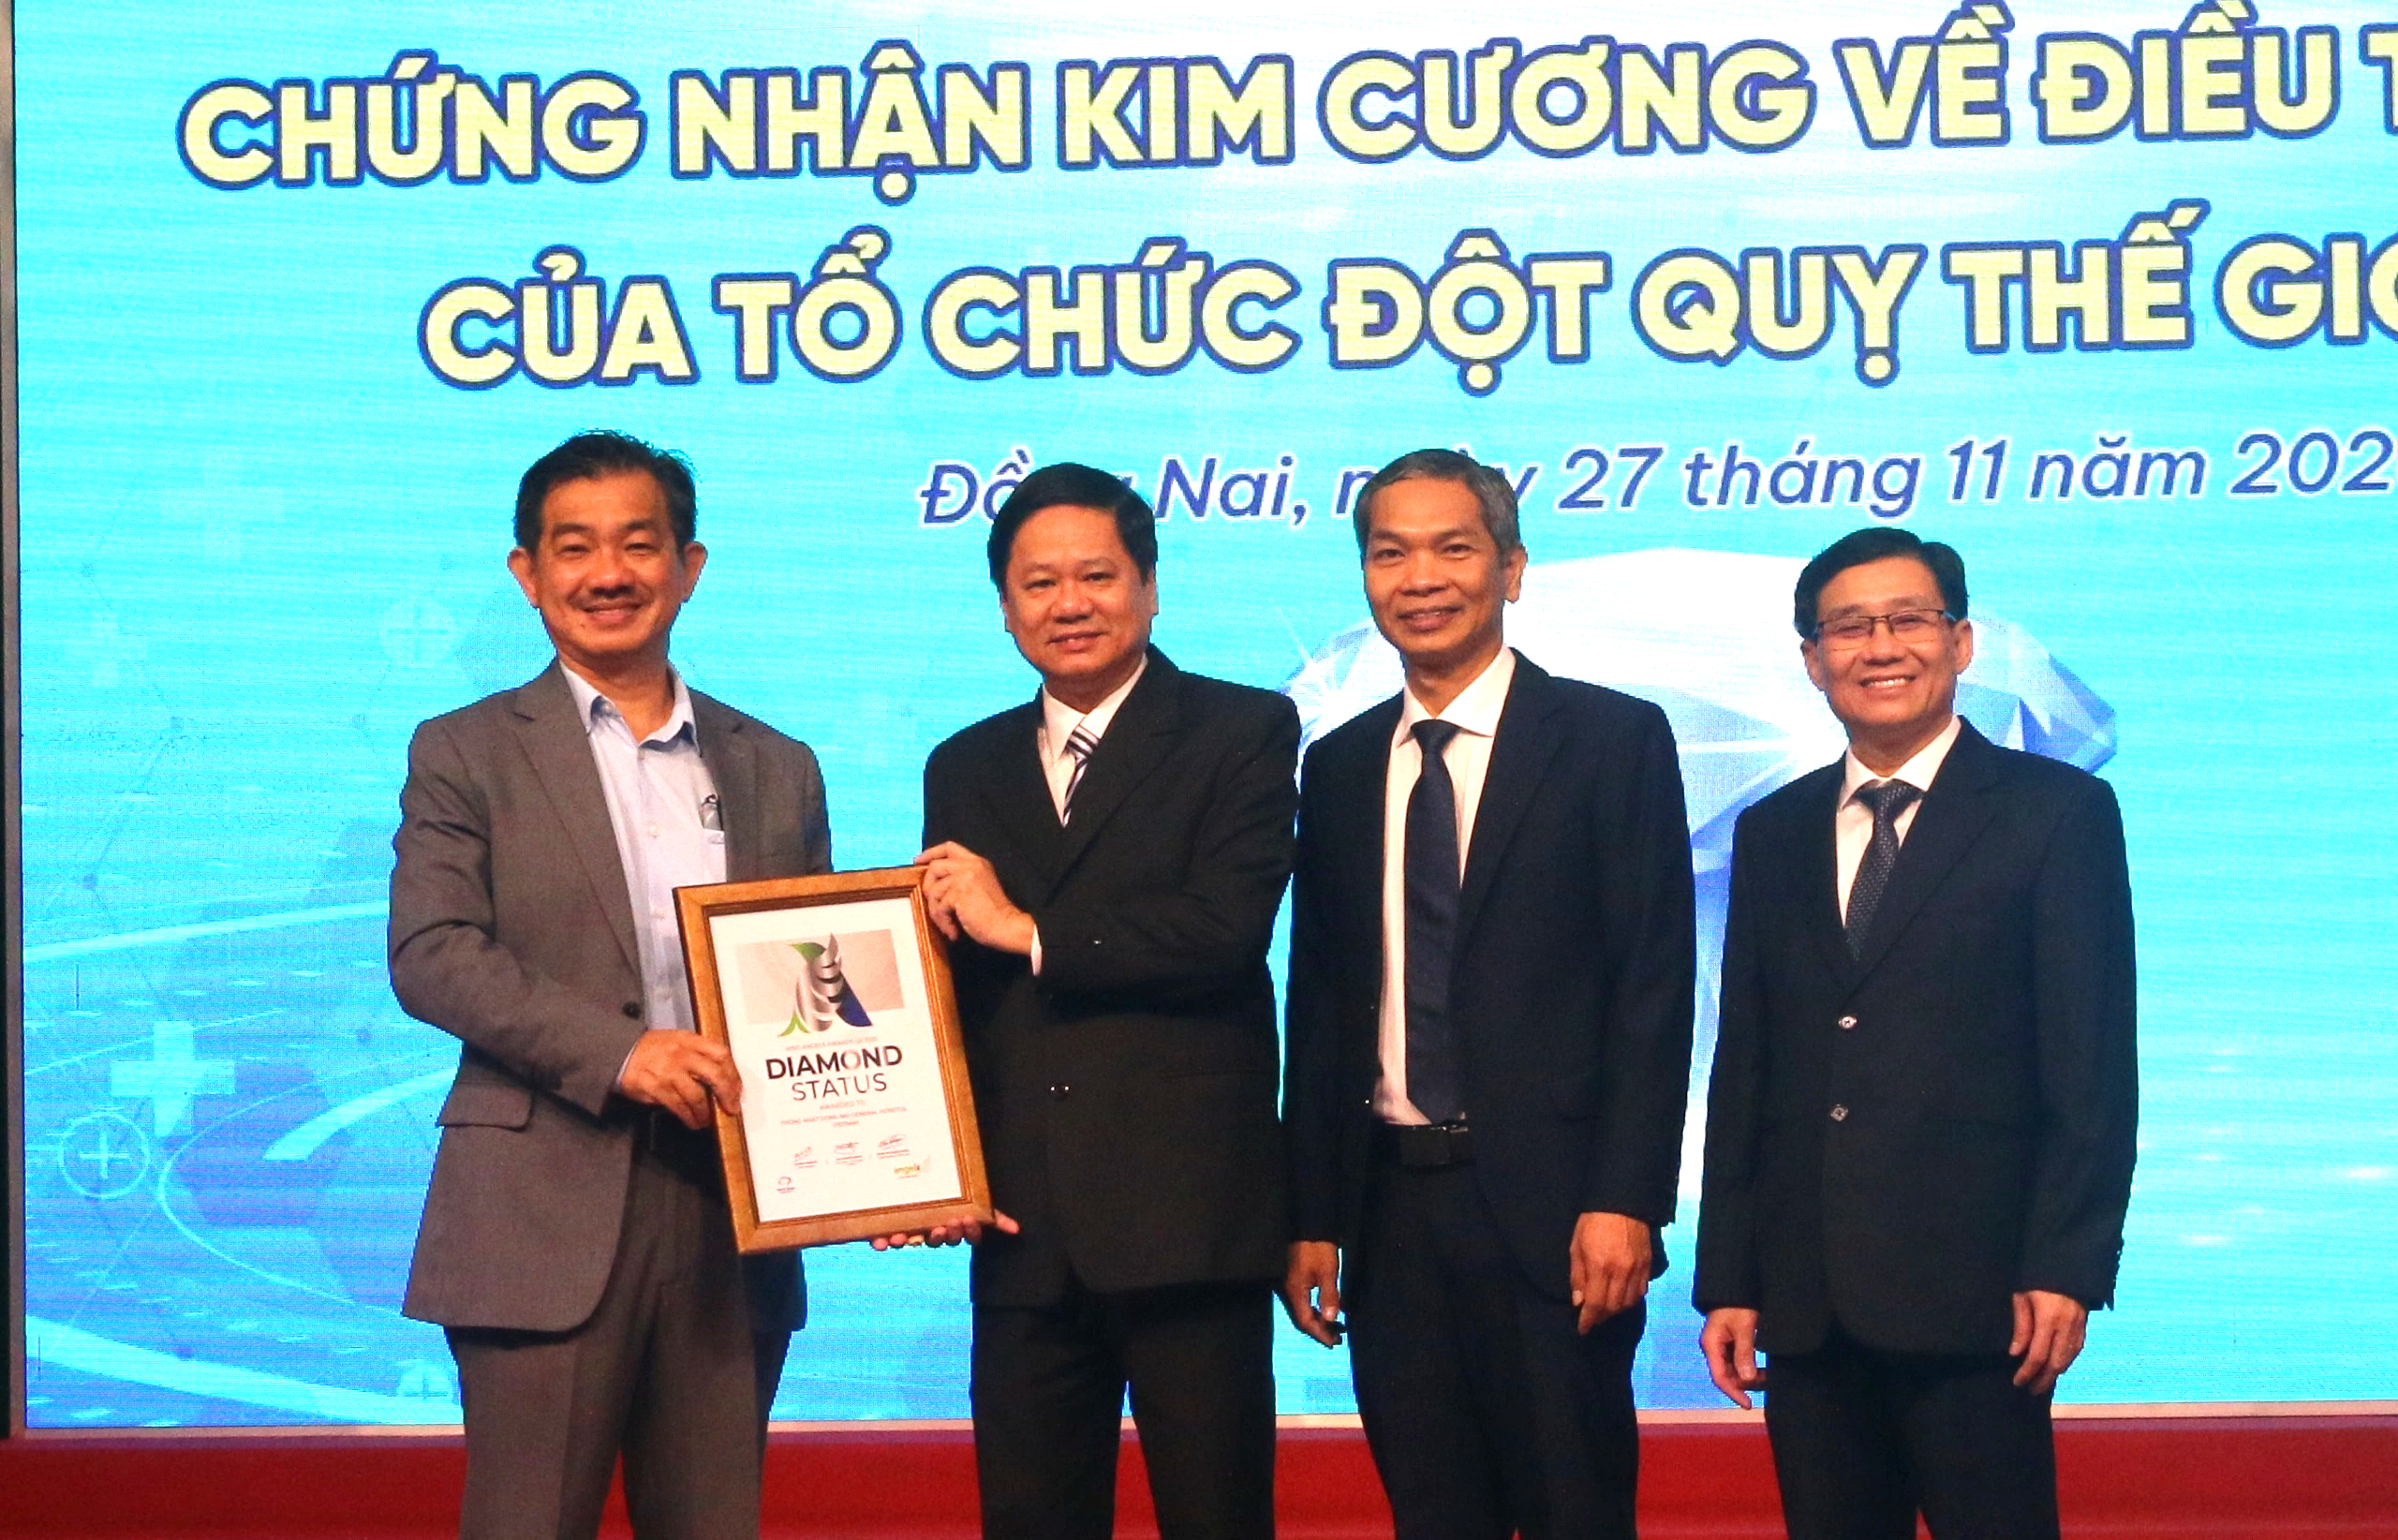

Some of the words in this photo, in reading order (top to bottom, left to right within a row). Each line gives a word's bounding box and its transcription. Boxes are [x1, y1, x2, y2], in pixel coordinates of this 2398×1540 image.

[178, 48, 646, 188] CHỨNG
[672, 40, 1030, 204] NHẬN
[1058, 54, 1295, 172] KIM
[1319, 36, 1816, 164] CƯƠNG
[1835, 0, 2015, 150] VỀ
[2030, 0, 2339, 145] ĐIỀU
[419, 245, 700, 391] CỦA
[712, 225, 902, 384] TỔ
[922, 235, 1301, 382] CHỨC
[1323, 229, 1611, 395] ĐỘT
[1632, 243, 1926, 390] QUỴ
[1943, 198, 2211, 354] THẾ
[1155, 455, 1309, 526] Nai,
[1558, 446, 1664, 511] 27
[1685, 438, 1921, 520] tháng
[1947, 437, 2008, 501] 11
[2029, 435, 2208, 499] năm
[765, 1044, 903, 1079] DIAMOND
[791, 1073, 888, 1102] STATUS
